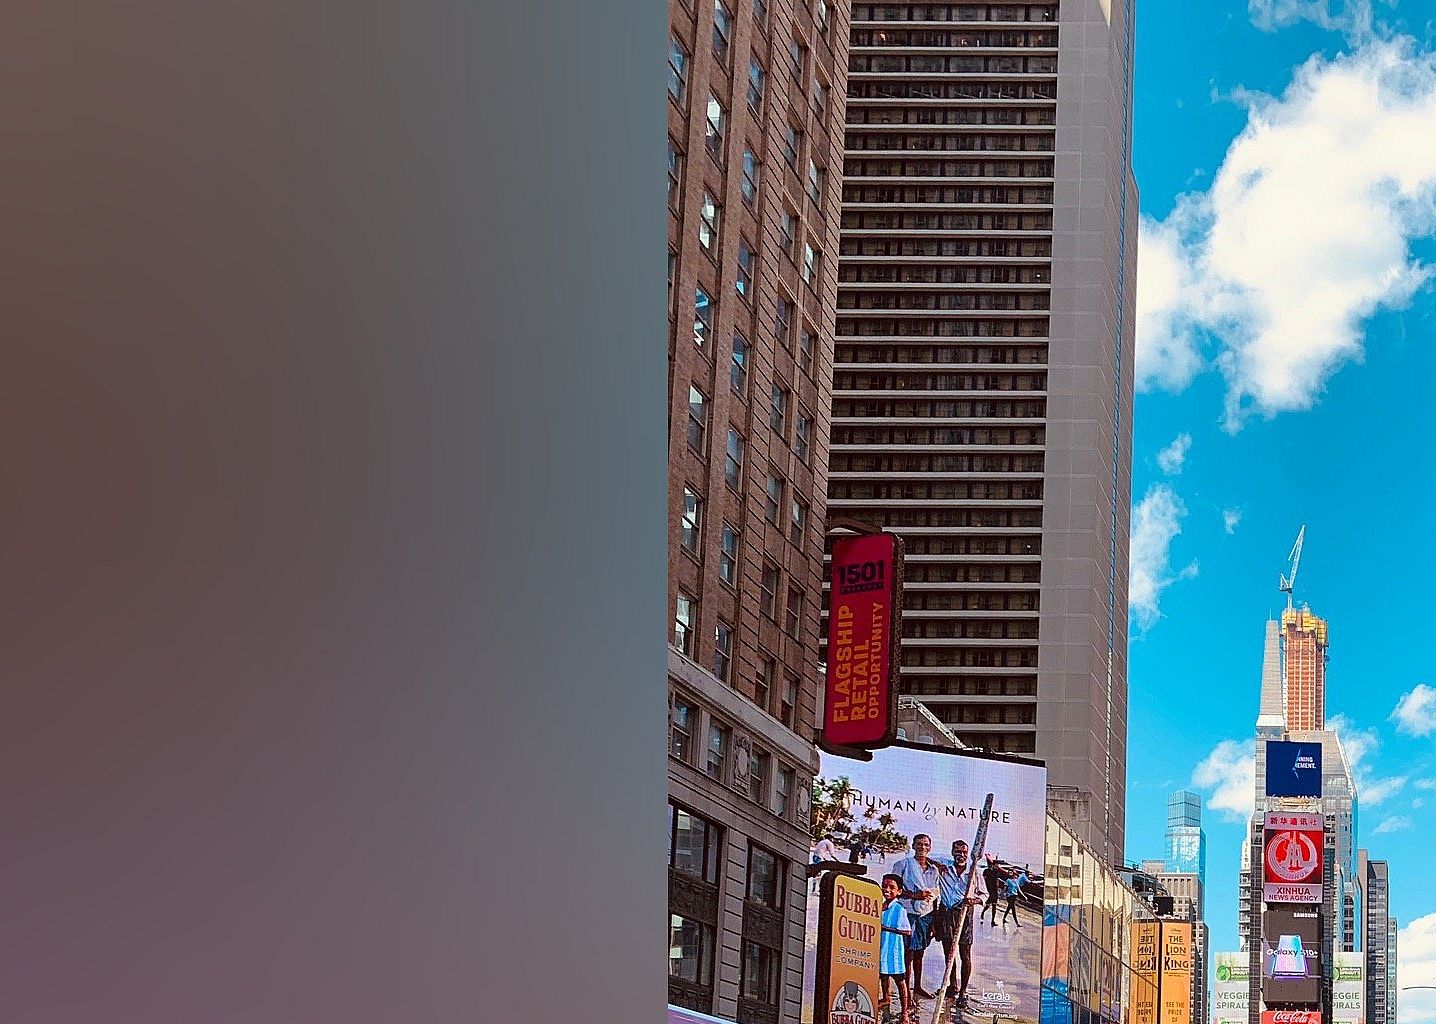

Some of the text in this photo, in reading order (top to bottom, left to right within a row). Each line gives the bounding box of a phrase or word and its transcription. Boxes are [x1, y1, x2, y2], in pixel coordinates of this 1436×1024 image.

[838, 560, 885, 586] 1501
[833, 605, 853, 723] FLAGSHIP
[868, 602, 884, 719] OPPORTUNITY
[851, 639, 869, 721] RETAIL
[852, 794, 916, 812] HUMAN
[922, 802, 941, 824] by
[1277, 887, 1311, 895] XINHUA
[836, 884, 880, 919] BUBBA
[838, 914, 876, 943] GUMP
[1168, 935, 1183, 943] THE
[840, 946, 872, 960] SHRIMP
[1165, 943, 1187, 956] LION
[1266, 948, 1299, 957] Galaxy
[835, 955, 874, 969] COMPANY
[1164, 956, 1189, 971] KING
[982, 987, 1011, 1001] kerala
[1217, 992, 1250, 1000] VEGGIE
[1333, 992, 1360, 1000] EGGIE
[1332, 1002, 1361, 1010] PIRALS
